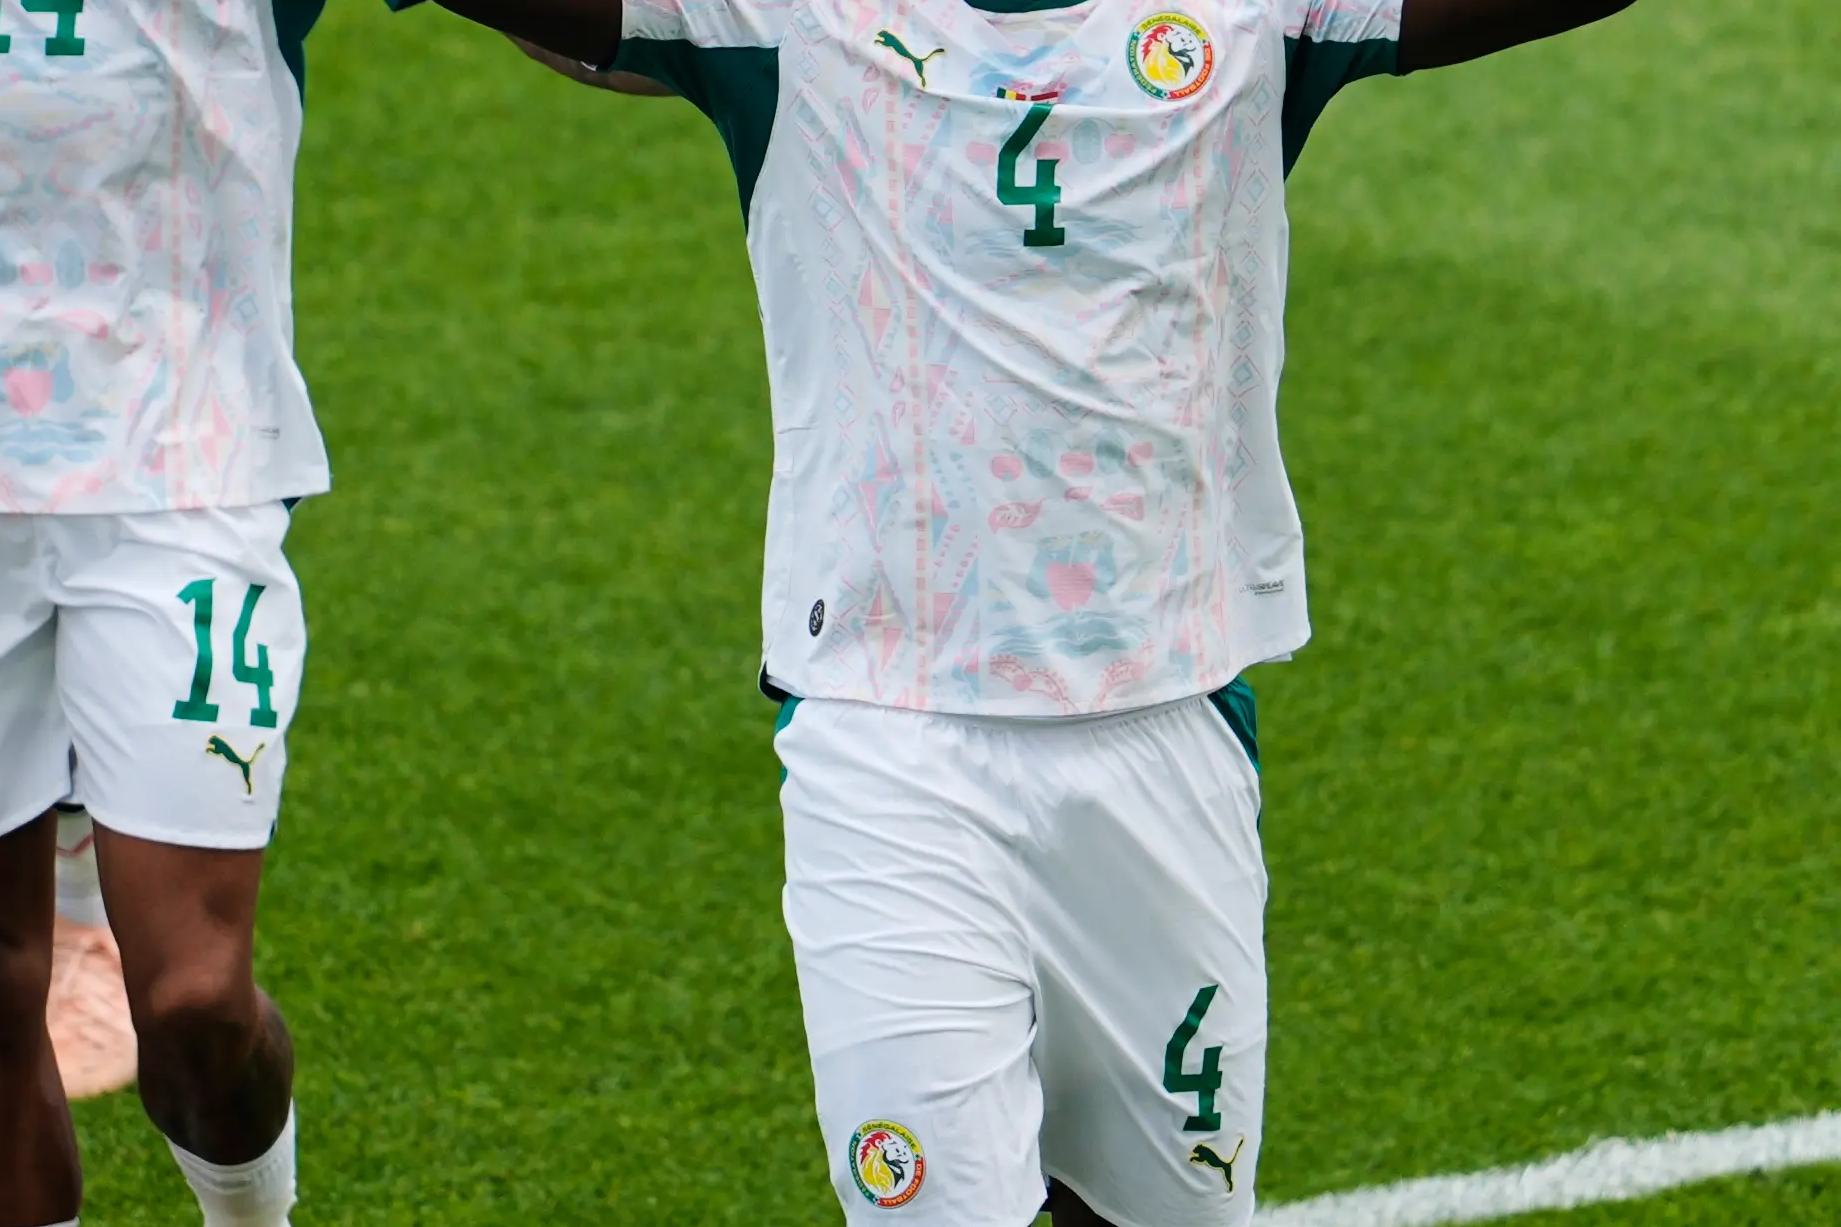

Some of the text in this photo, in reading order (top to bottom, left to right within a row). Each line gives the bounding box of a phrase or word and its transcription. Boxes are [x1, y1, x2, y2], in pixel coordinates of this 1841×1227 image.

[996, 102, 1065, 248] 4
[172, 579, 278, 729] 14
[1162, 984, 1223, 1132] 4
